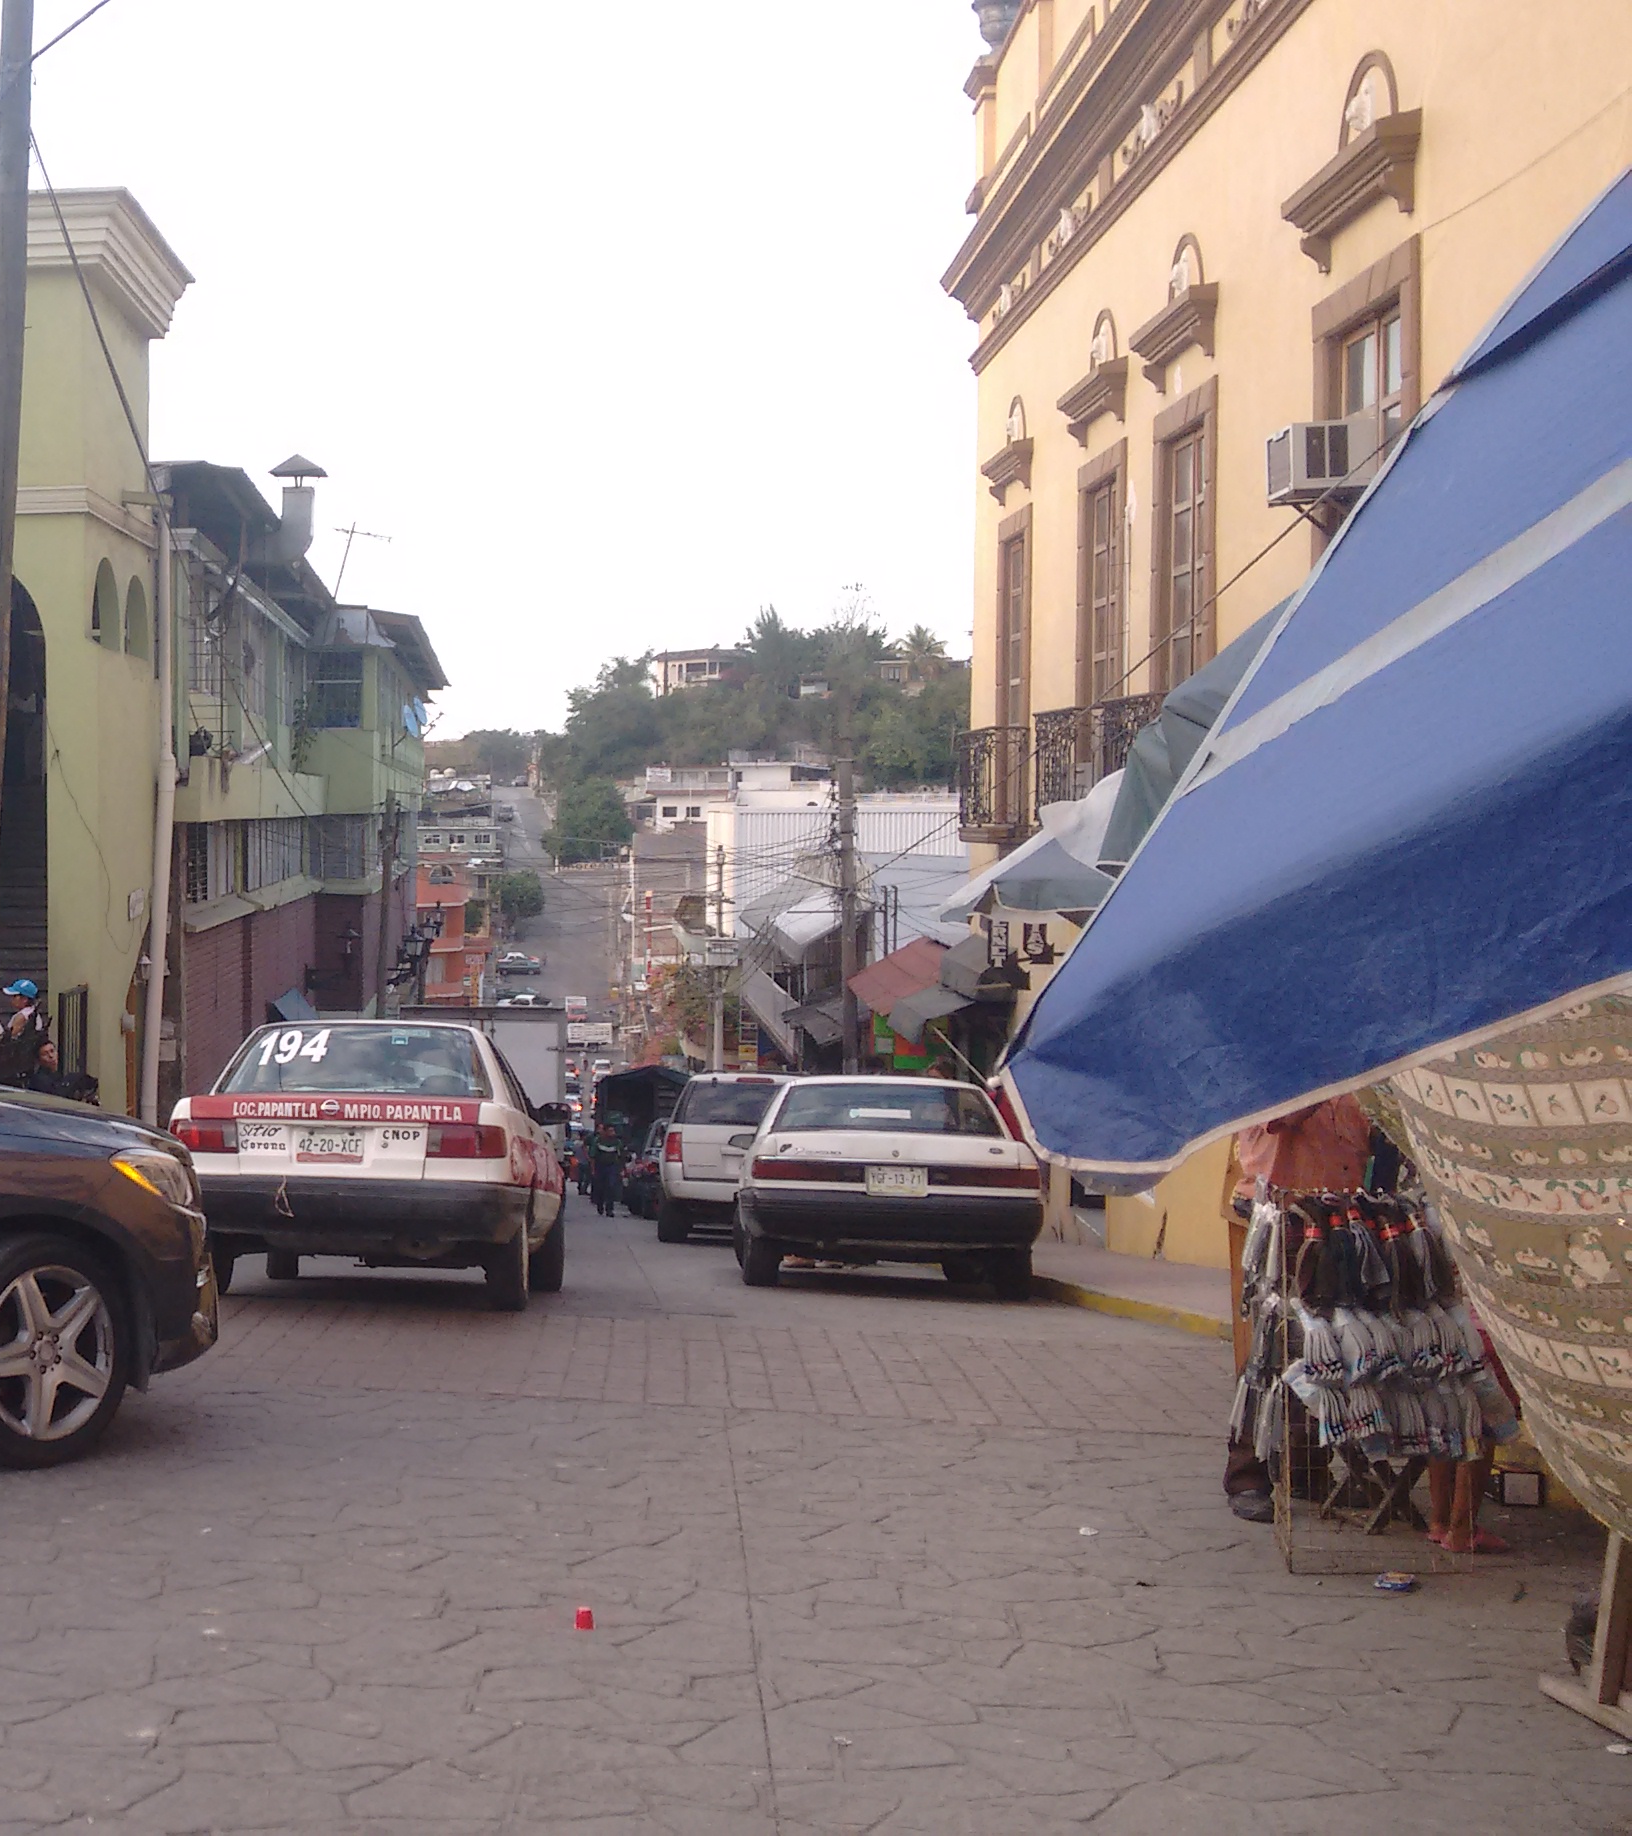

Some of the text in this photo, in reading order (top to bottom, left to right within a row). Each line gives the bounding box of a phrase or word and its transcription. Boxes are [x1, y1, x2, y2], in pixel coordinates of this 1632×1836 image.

[258, 1029, 332, 1066] 194
[344, 1105, 383, 1119] MPIO.
[386, 1105, 462, 1121] PAPANTLA
[239, 1124, 282, 1137] Sitio
[382, 1129, 421, 1140] CNOP
[298, 1138, 362, 1153] 42-20-XCF
